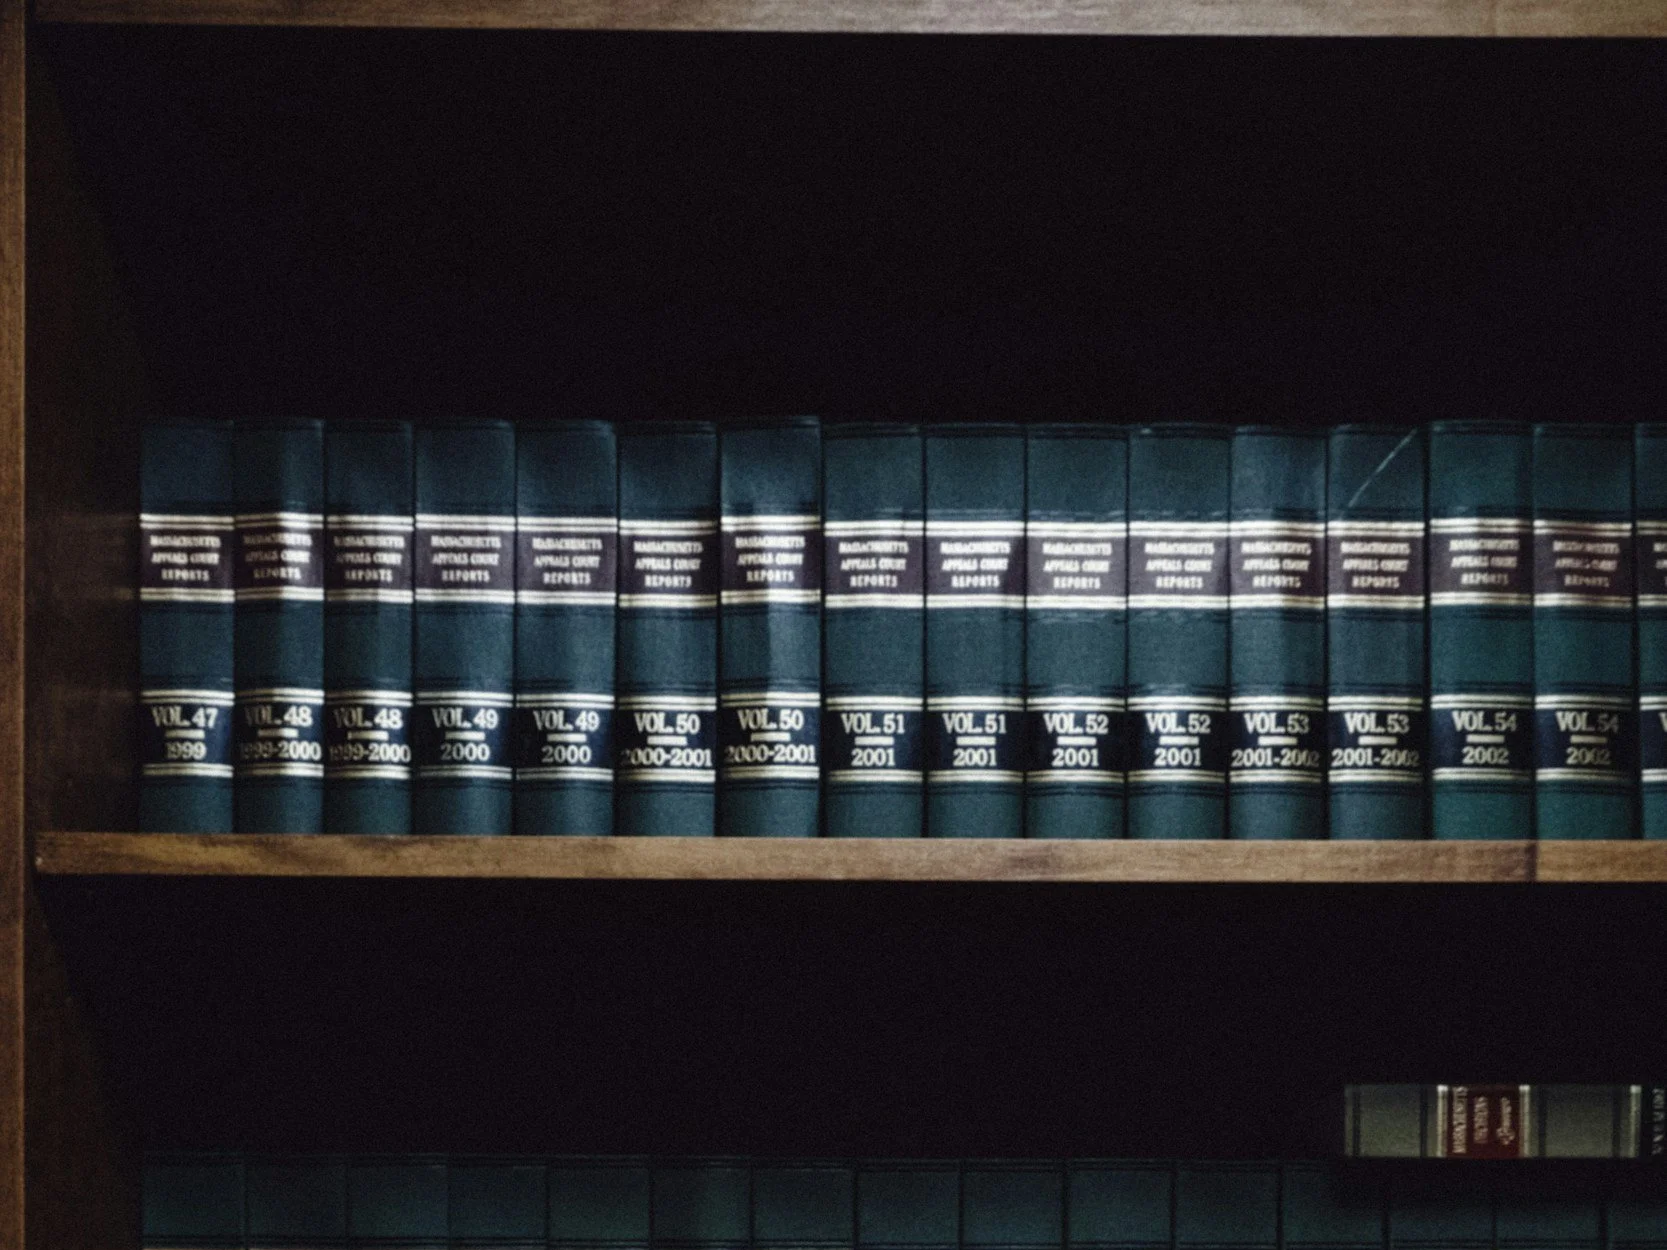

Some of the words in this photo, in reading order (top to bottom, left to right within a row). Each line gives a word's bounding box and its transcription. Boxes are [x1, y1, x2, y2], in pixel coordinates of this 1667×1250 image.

[150, 535, 220, 548] MASSACHUSETTS
[431, 535, 501, 548] MASSACHUSETTS
[533, 537, 602, 551] MASSACHUSETTS
[634, 541, 702, 554] MASSACHUSETTS
[735, 535, 805, 549] MASSACHUSETTS
[839, 540, 908, 554] MASSACHUSETTS
[941, 540, 1011, 556] MASSACHUSETTS
[1145, 541, 1214, 556] MASSACHUSETTS
[1242, 541, 1311, 555] MASSACHUSETTS
[1341, 541, 1410, 555] MASSACHUSETTS
[1449, 538, 1520, 552] MASSACHUSETTS
[1043, 542, 1112, 556] MASSACHUSETTS
[151, 552, 187, 565] APPEALS
[190, 552, 219, 565] COURT
[281, 548, 310, 565] COURT
[374, 552, 402, 565] COURT
[433, 553, 468, 565] APPEALS
[471, 553, 499, 565] COURT
[535, 555, 570, 568] APPEALS
[573, 555, 600, 568] COURT
[737, 552, 772, 566] APPEALS
[776, 552, 803, 566] COURT
[1451, 555, 1488, 568] APPEALS
[1491, 555, 1517, 568] COURT
[635, 557, 670, 571] APPEALS
[673, 557, 701, 571] COURT
[841, 557, 876, 571] APPEALS
[879, 557, 906, 571] COURT
[941, 557, 977, 572] APPEALS
[980, 557, 1008, 572] COURT
[1044, 559, 1079, 574] APPEALS
[1082, 559, 1109, 574] COURT
[1146, 558, 1182, 573] APPEALS
[1184, 558, 1212, 573] COURT
[1243, 558, 1279, 571] APPEALS
[1282, 558, 1309, 571] COURT
[1343, 558, 1378, 571] APPEALS
[1381, 558, 1409, 571] COURT
[162, 569, 209, 580] REPORTS
[254, 567, 301, 579] REPORTS
[345, 570, 392, 580] REPORTS
[442, 570, 489, 581] REPORTS
[544, 572, 591, 585] REPORTS
[746, 569, 794, 583] REPORTS
[1461, 573, 1508, 586] REPORTS
[644, 575, 691, 588] REPORTS
[851, 574, 897, 587] REPORTS
[952, 574, 999, 588] REPORTS
[1054, 576, 1100, 590] REPORTS
[1156, 575, 1202, 590] REPORTS
[1253, 575, 1301, 588] REPORTS
[1352, 576, 1399, 588] REPORTS
[1565, 576, 1609, 587] REPORTS
[165, 743, 206, 758] 1999
[441, 744, 489, 761] 2000
[542, 746, 591, 763] 2000
[726, 745, 815, 763] 2000-2001
[852, 749, 895, 766] 2001
[953, 749, 996, 766] 2001
[1154, 749, 1201, 766] 2001
[1232, 749, 1319, 766] 2001-2002
[1332, 749, 1419, 766] 2001-2002
[1462, 748, 1508, 764] 2002
[1566, 748, 1610, 765] 2002
[1052, 749, 1099, 767] 2001
